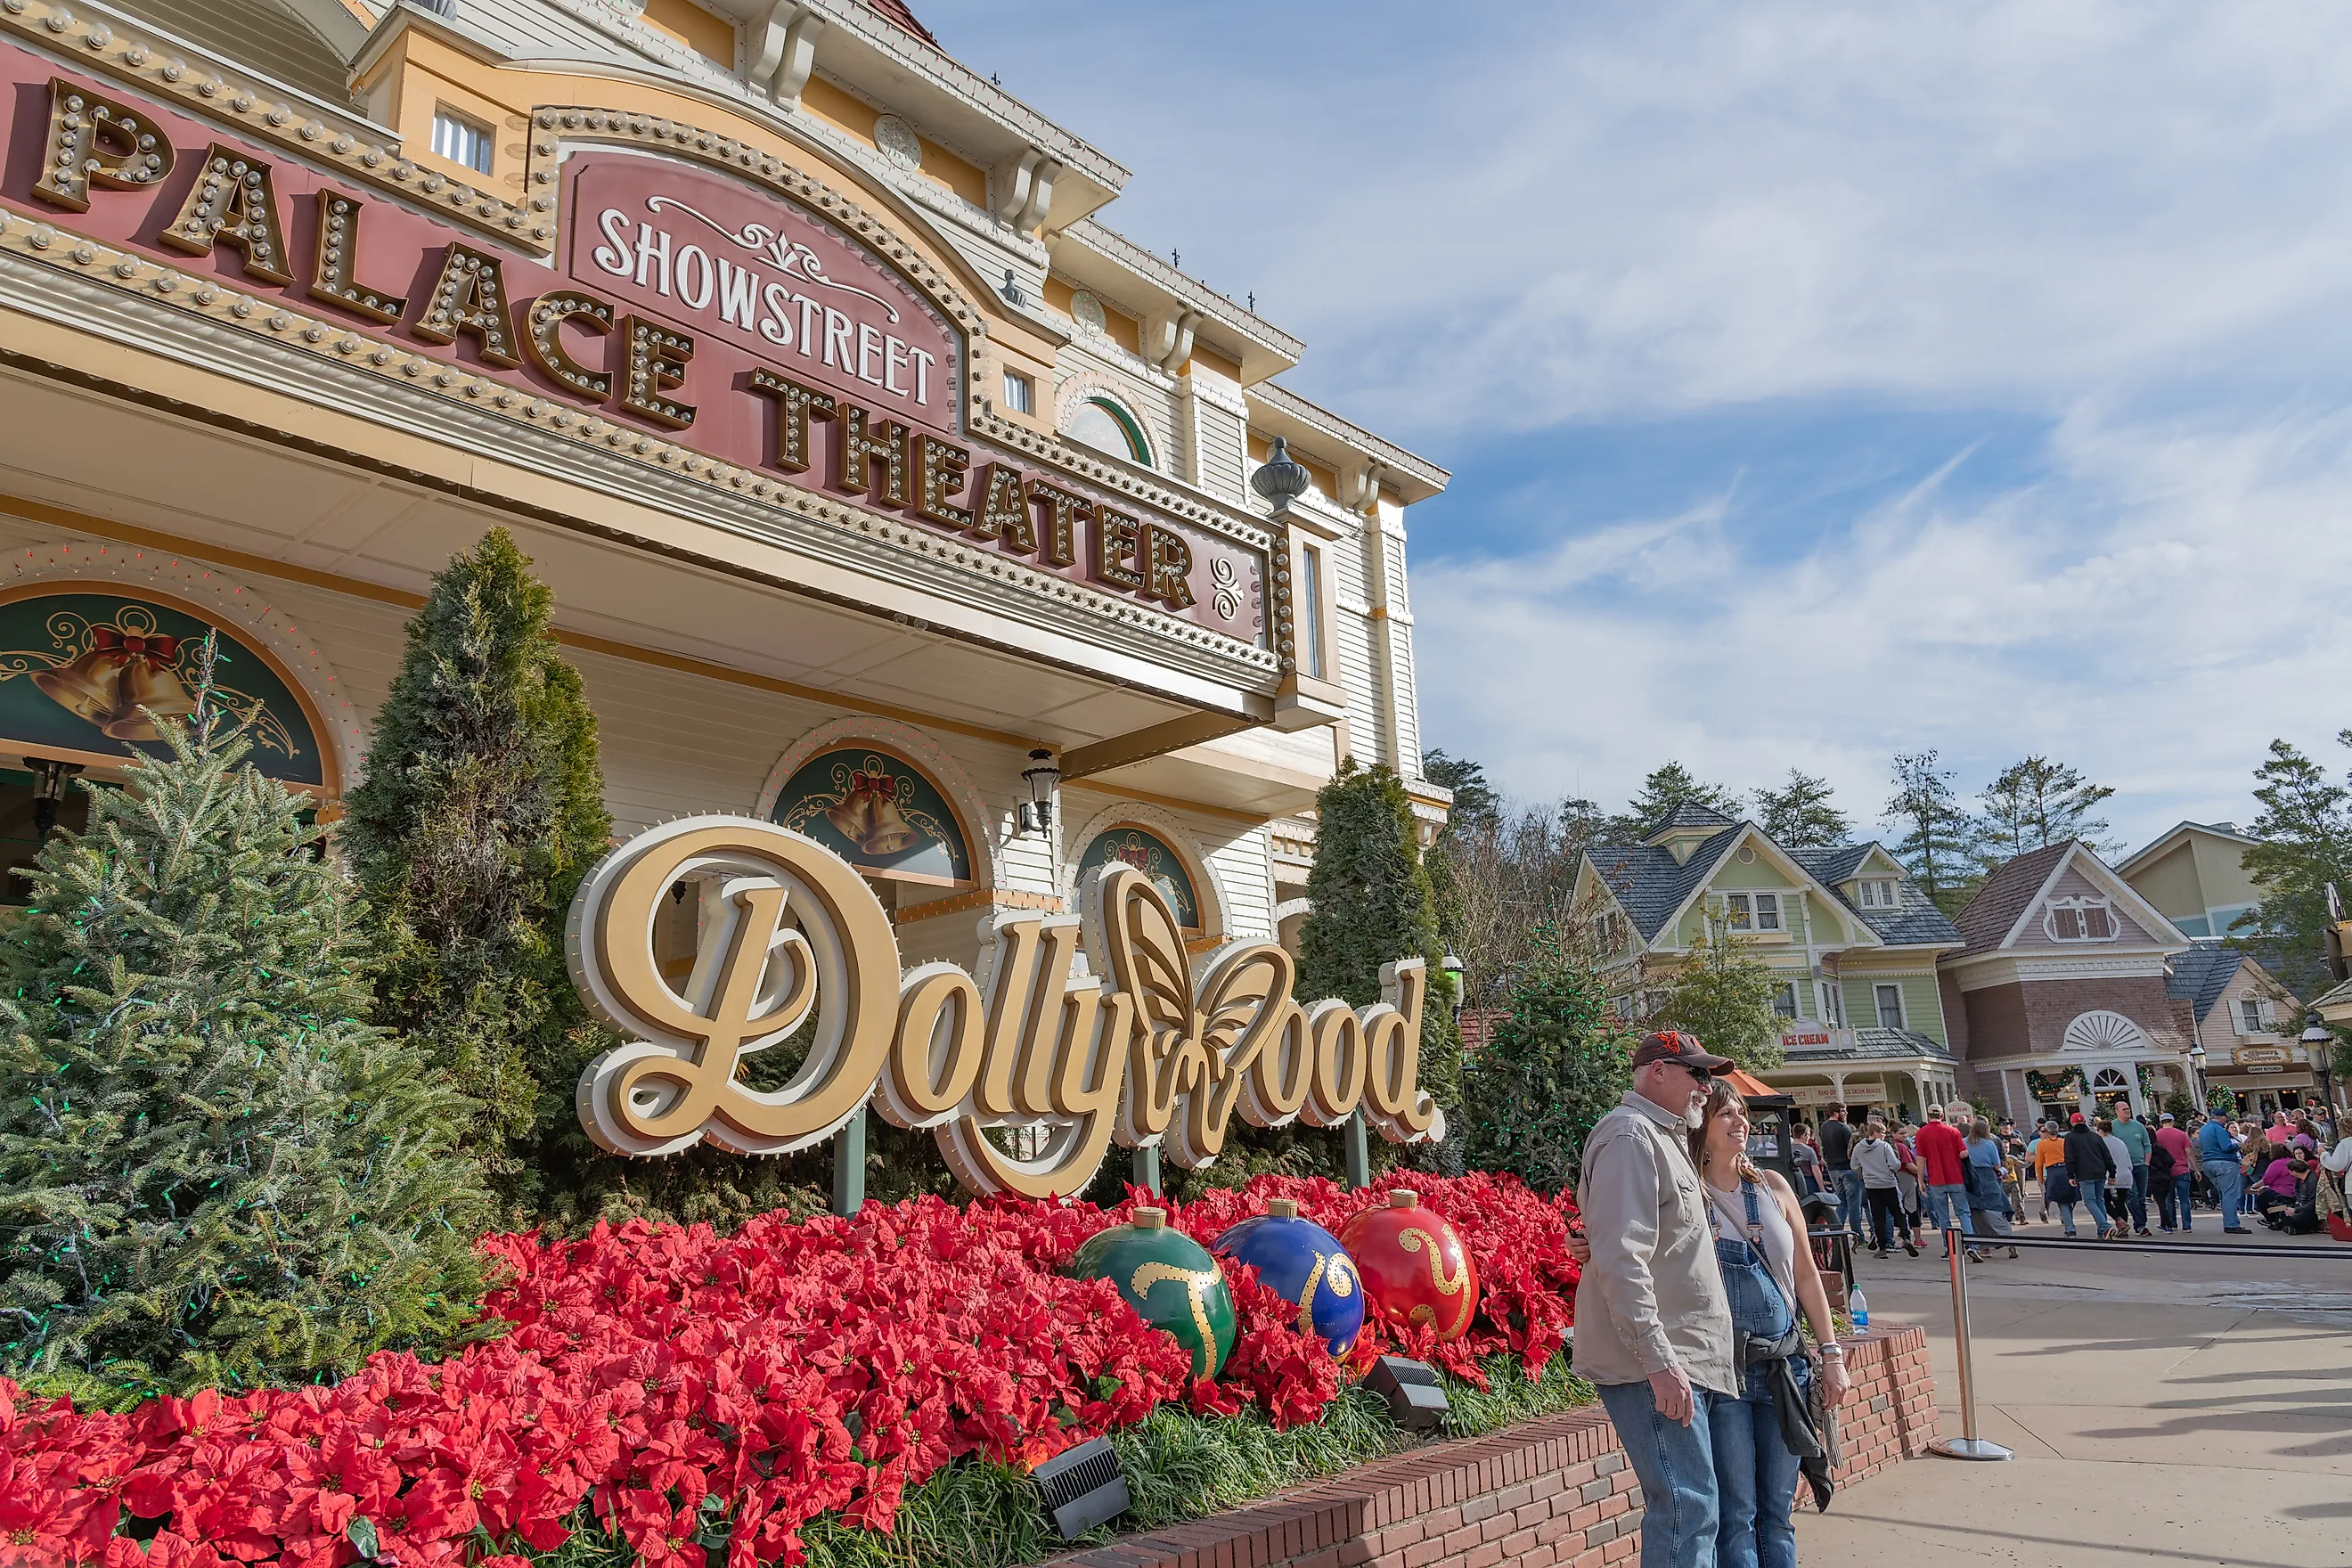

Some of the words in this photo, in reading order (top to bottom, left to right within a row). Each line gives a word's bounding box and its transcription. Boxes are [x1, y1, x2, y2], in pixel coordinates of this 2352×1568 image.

[30, 75, 698, 431] PALACE
[748, 365, 1197, 610] THEATER
[592, 208, 937, 408] SHOWSTREET
[1782, 1034, 1798, 1046] ICE
[1798, 1033, 1830, 1045] CREAM
